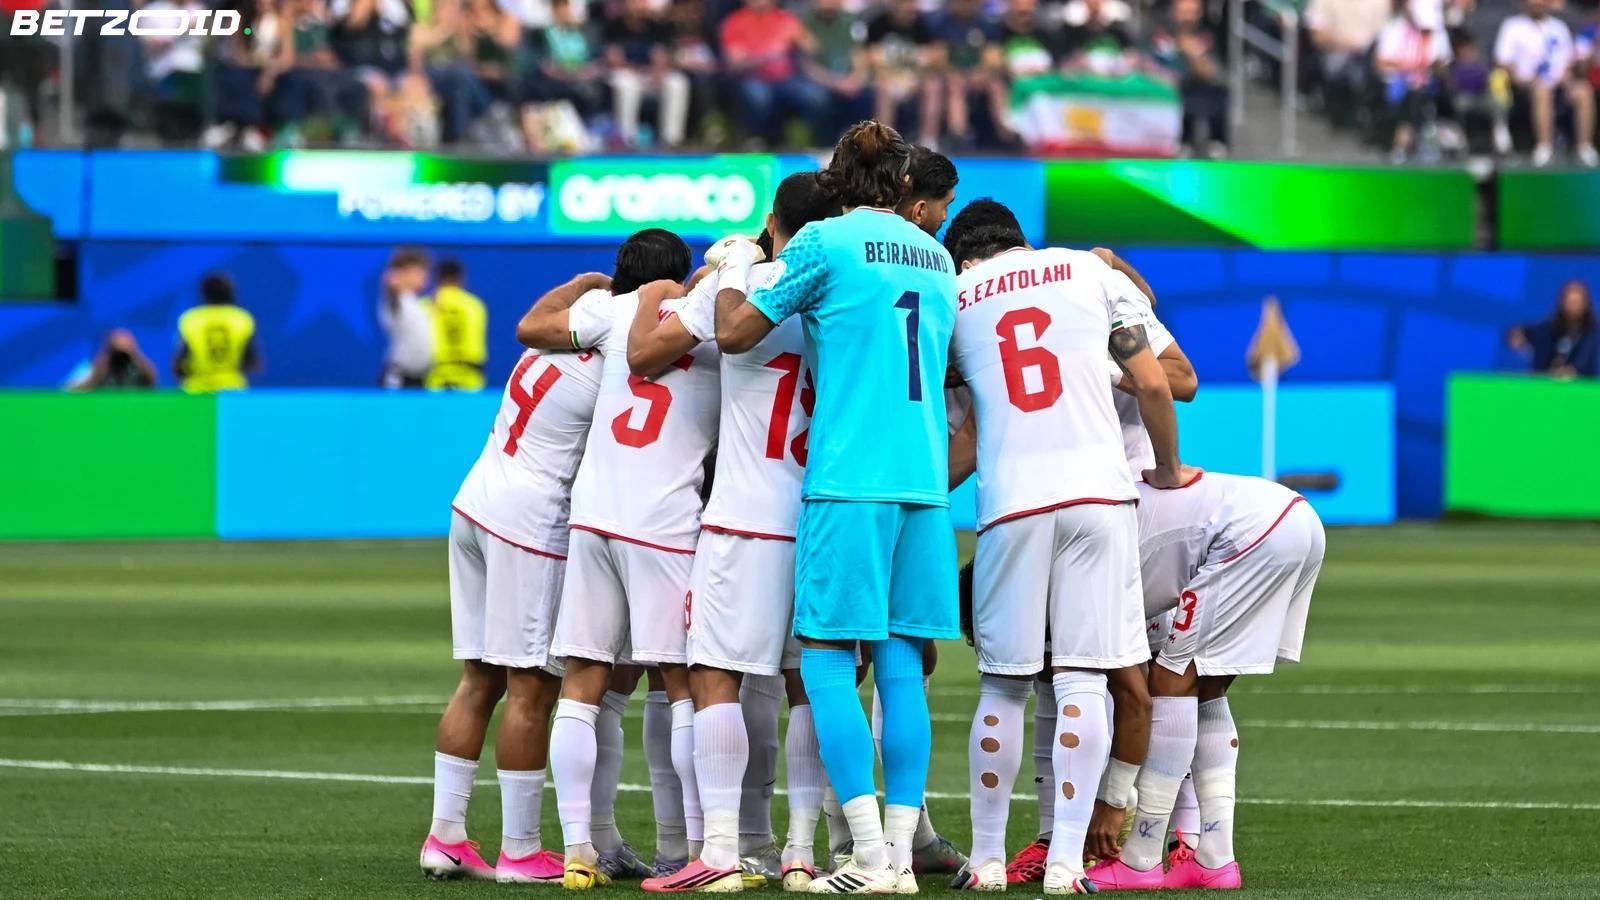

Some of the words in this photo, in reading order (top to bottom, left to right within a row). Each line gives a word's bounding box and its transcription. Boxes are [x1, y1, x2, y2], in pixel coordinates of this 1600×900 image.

[337, 184, 494, 221] POWERED
[497, 183, 543, 222] BY
[560, 174, 757, 223] aramco
[865, 241, 948, 273] BEIRANVAND
[958, 263, 1071, 311] S.EZATOLAHI
[893, 290, 922, 401] 1
[995, 306, 1063, 412] 6
[491, 355, 563, 457] 4
[611, 354, 695, 448] 5
[1172, 590, 1198, 632] 3
